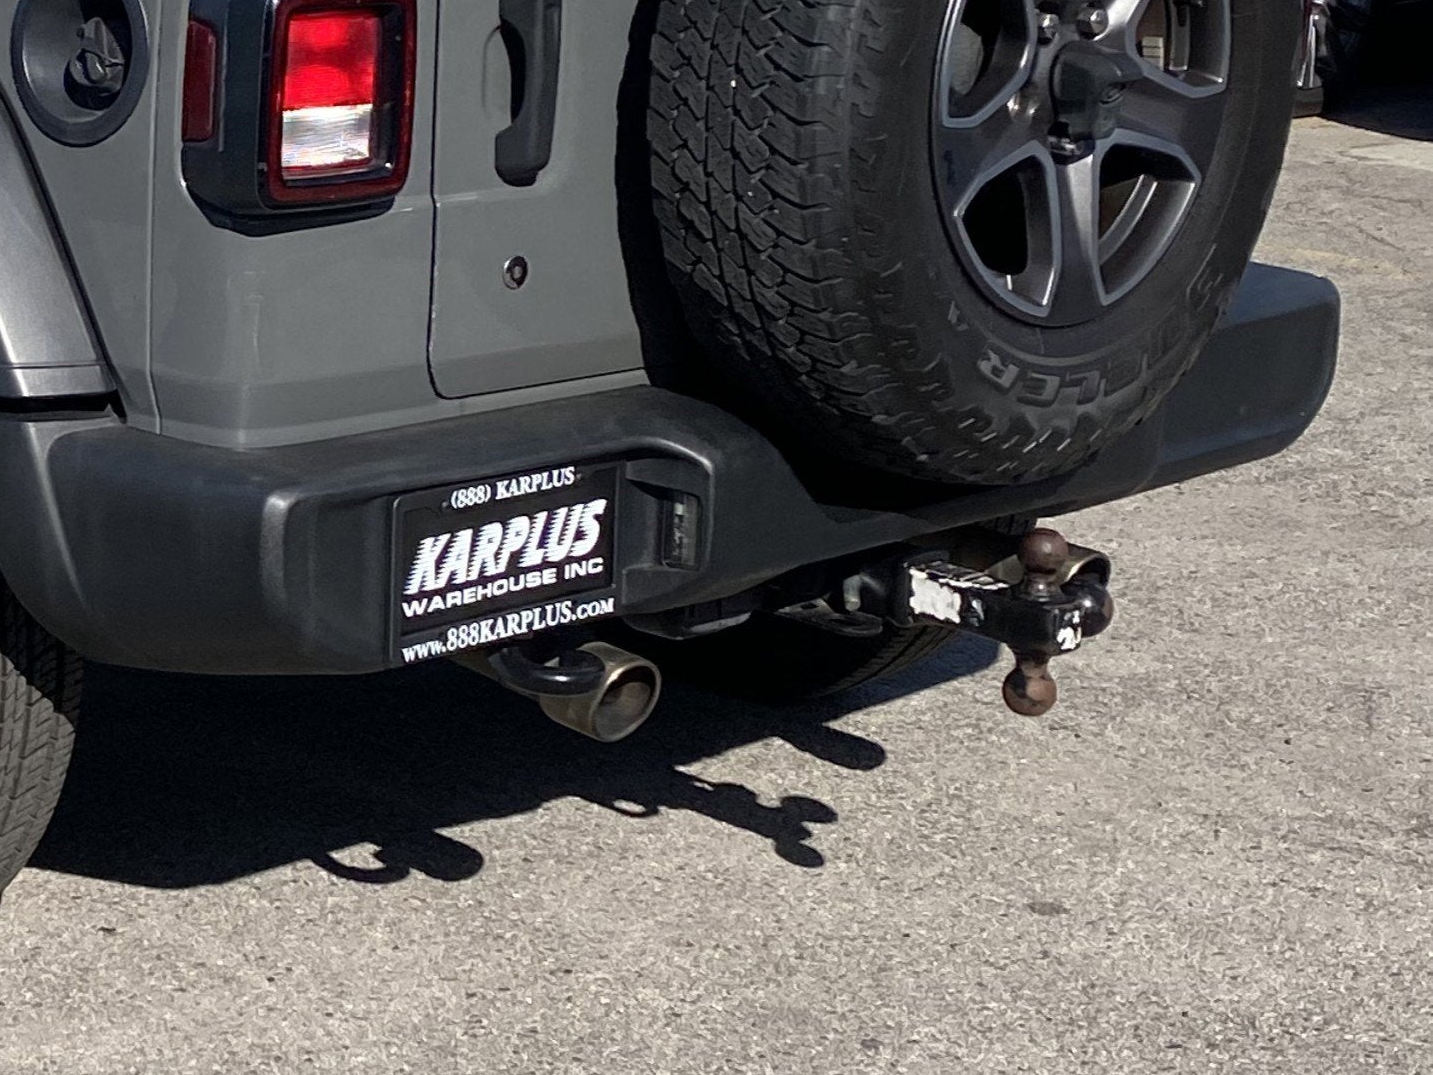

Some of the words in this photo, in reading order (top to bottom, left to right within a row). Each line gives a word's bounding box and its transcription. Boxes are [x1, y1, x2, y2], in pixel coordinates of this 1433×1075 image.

[451, 483, 491, 509] (888)
[495, 466, 575, 500] KARPLUS
[403, 498, 608, 595] KARPLUS
[401, 568, 557, 618] WAREHOUSE
[563, 557, 603, 580] INC
